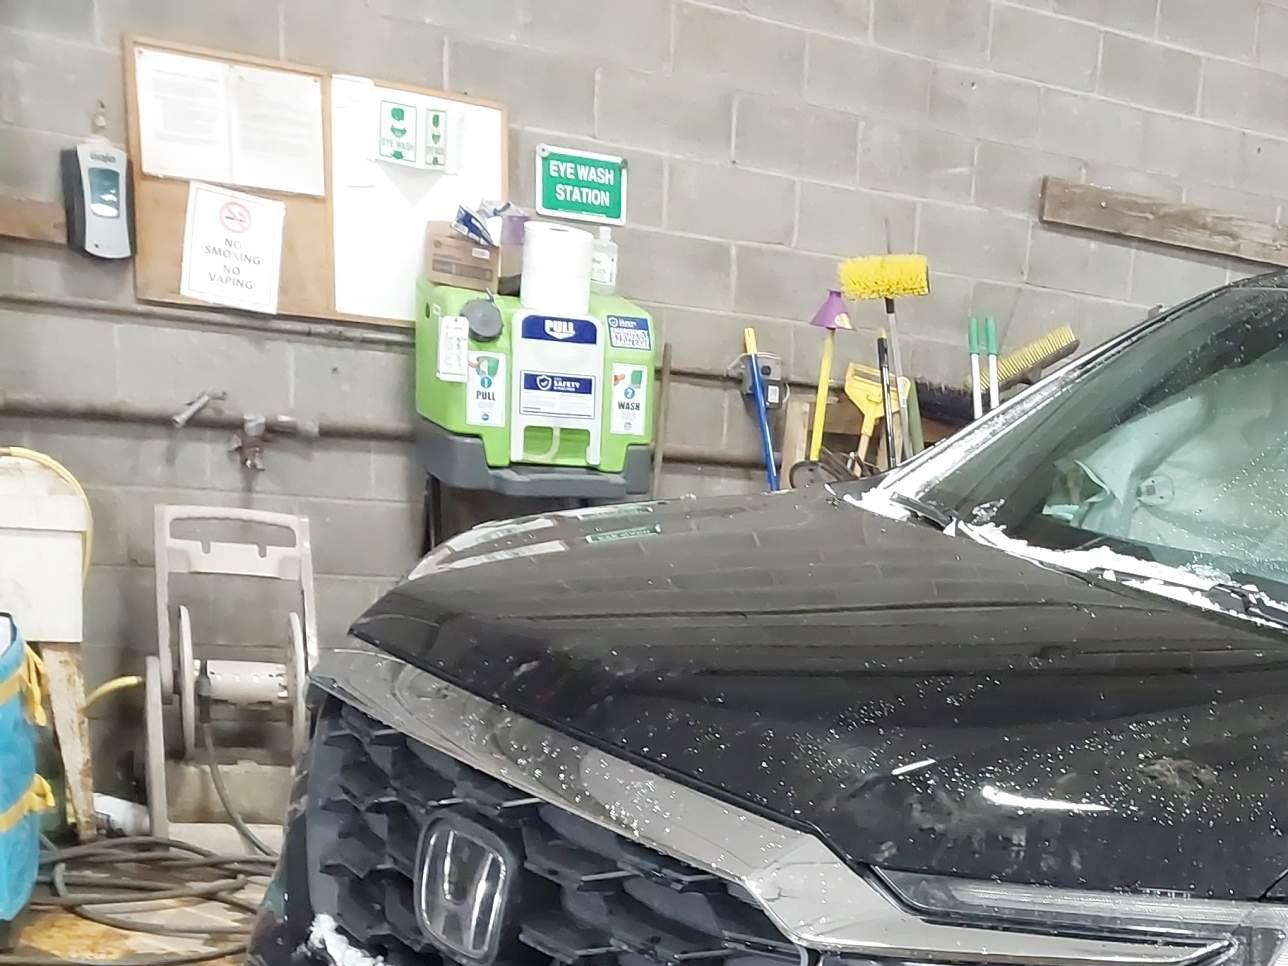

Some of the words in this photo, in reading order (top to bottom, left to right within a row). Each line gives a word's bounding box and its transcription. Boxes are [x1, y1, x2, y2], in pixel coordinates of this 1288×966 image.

[549, 159, 576, 179] EYE
[576, 163, 615, 186] WASH
[555, 183, 611, 207] STATION
[224, 237, 242, 249] NO
[223, 264, 241, 276] NO
[208, 271, 253, 290] VAPING
[545, 319, 575, 334] PULL
[476, 390, 497, 401] PULL
[617, 401, 641, 411] WASH
